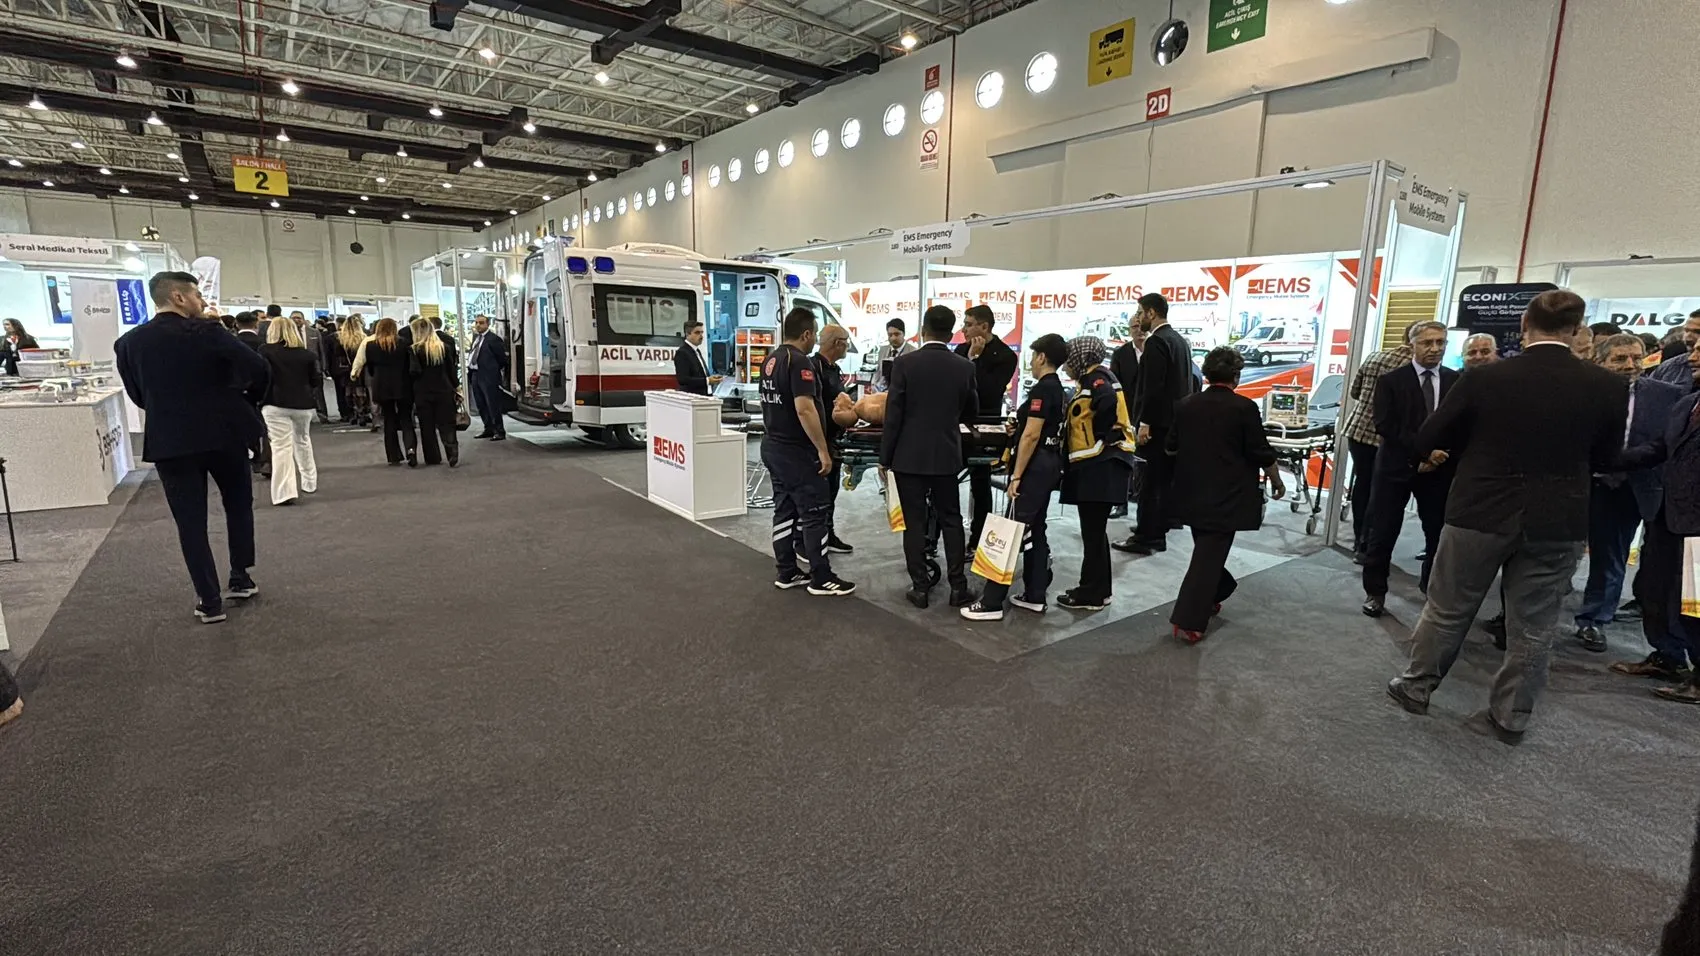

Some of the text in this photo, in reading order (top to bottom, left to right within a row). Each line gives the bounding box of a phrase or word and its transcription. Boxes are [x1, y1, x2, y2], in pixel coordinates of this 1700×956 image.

[1148, 94, 1169, 115] 2D
[255, 171, 270, 190] 2
[1422, 186, 1449, 208] Emergency
[1408, 202, 1446, 224] Mobile Systems
[903, 230, 953, 242] EMS Emergency
[9, 243, 109, 255] Seral Medikal Tekstil
[903, 244, 924, 254] Mobile
[924, 243, 952, 253] Systems
[1106, 285, 1143, 301] EMS
[1264, 276, 1311, 294] EMS
[1044, 293, 1077, 309] EMS
[1175, 285, 1220, 302] EMS
[872, 303, 890, 314] EMS
[996, 312, 1013, 322] EMS
[601, 346, 676, 361] ACİL YARDI
[1328, 363, 1346, 374] EM
[662, 438, 685, 465] EMS
